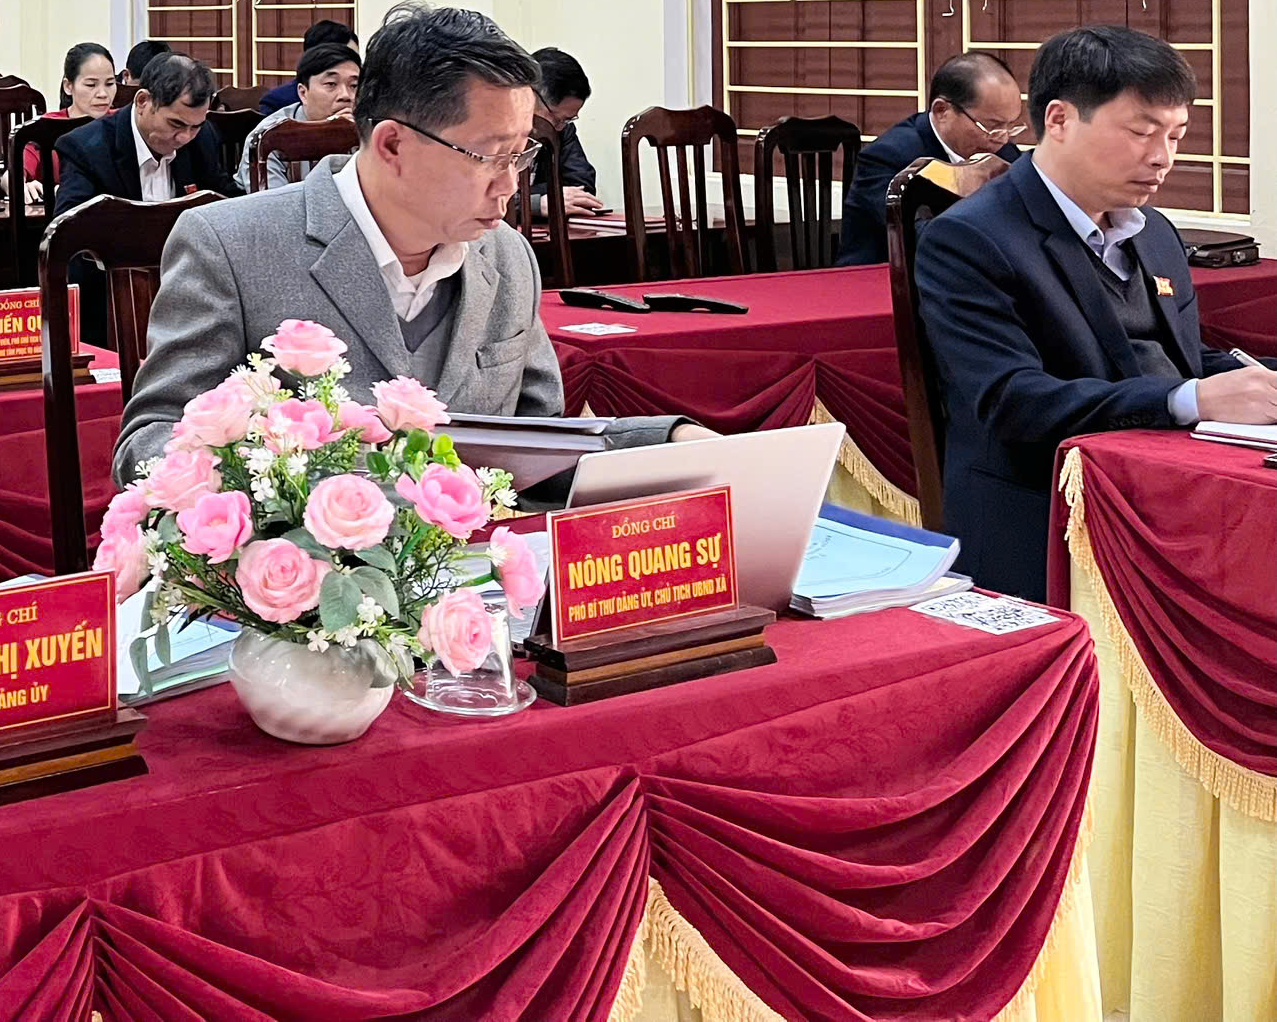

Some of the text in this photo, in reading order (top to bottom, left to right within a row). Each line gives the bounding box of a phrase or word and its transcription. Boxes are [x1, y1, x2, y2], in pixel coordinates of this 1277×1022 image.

[653, 511, 676, 531] CHÍ
[568, 532, 722, 590] NÔNG QUANG SỰ
[6, 601, 39, 624] CHÍ
[24, 620, 103, 671] XUYẾN
[30, 681, 49, 704] ỦY
